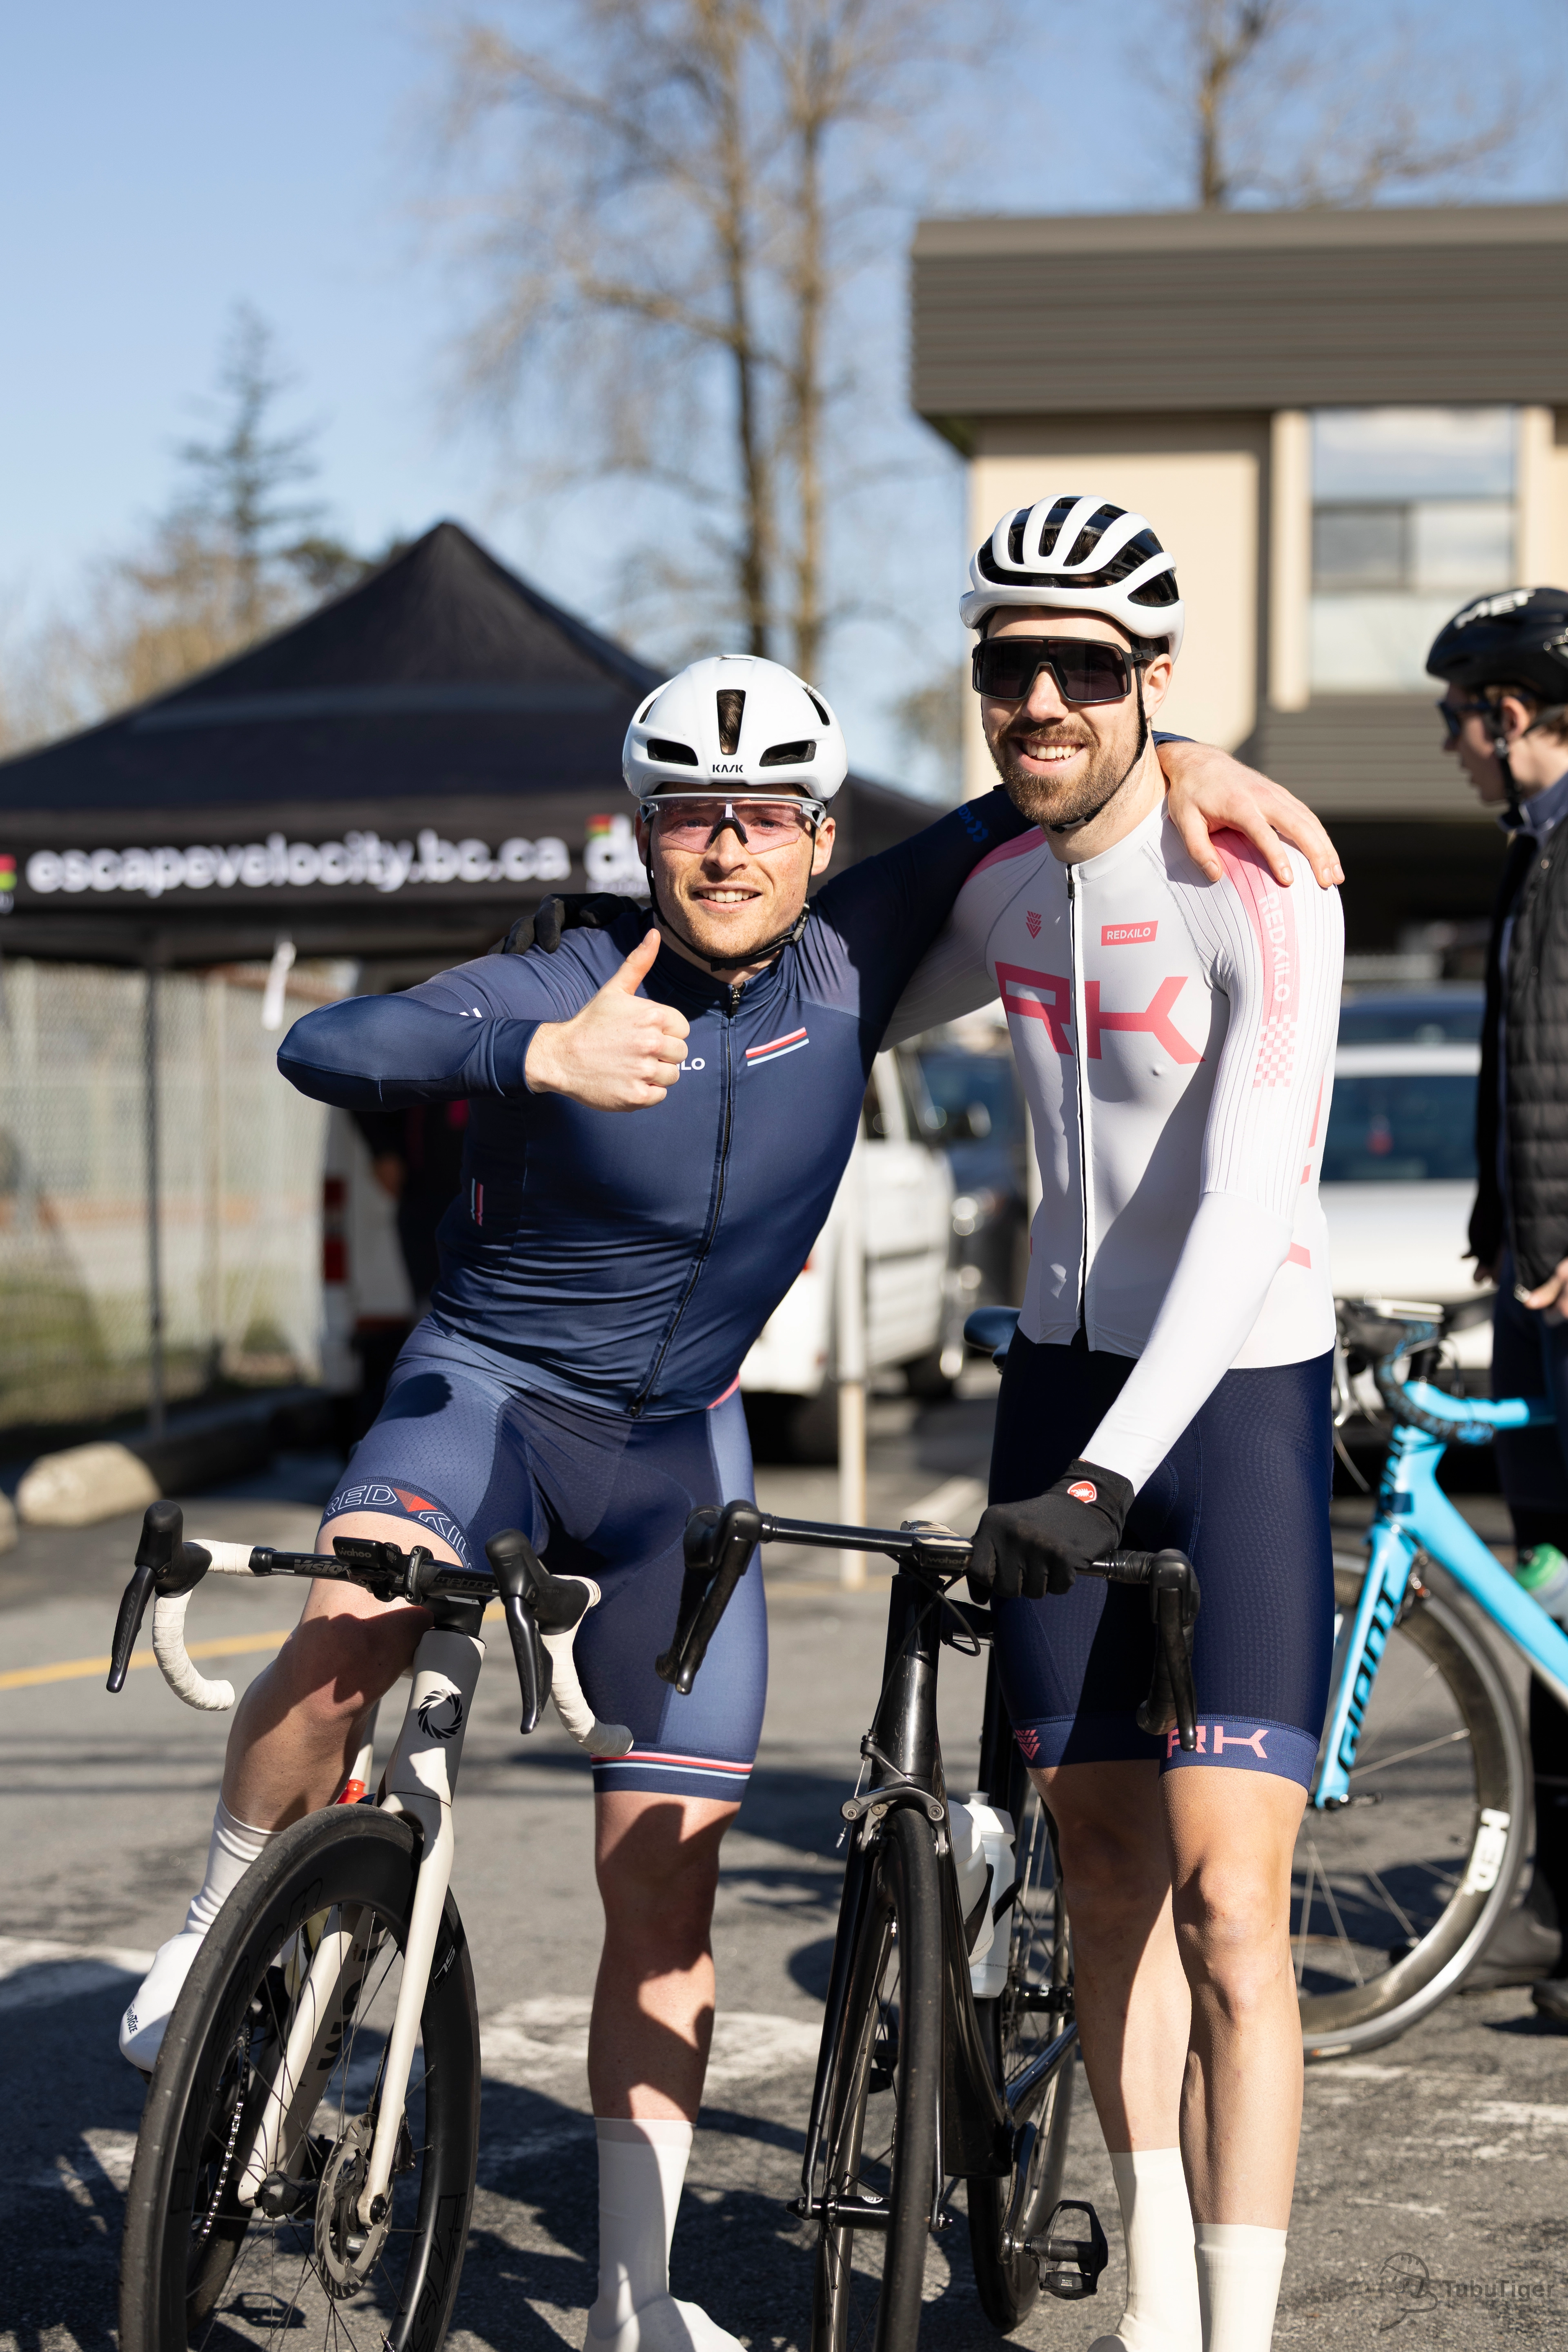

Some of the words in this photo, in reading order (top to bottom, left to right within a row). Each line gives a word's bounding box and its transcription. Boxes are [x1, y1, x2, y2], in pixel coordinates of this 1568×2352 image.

[1453, 588, 1536, 629] MET
[712, 764, 744, 773] KASK
[26, 828, 571, 898] escapevelocity.bc.ca
[1106, 927, 1152, 940] REDKILO
[1258, 891, 1290, 1002] REDKILO
[995, 962, 1206, 1065] RK
[337, 1547, 372, 1558] wahoo
[436, 1576, 497, 1589] metron
[116, 1592, 136, 1669] ULTEGRA
